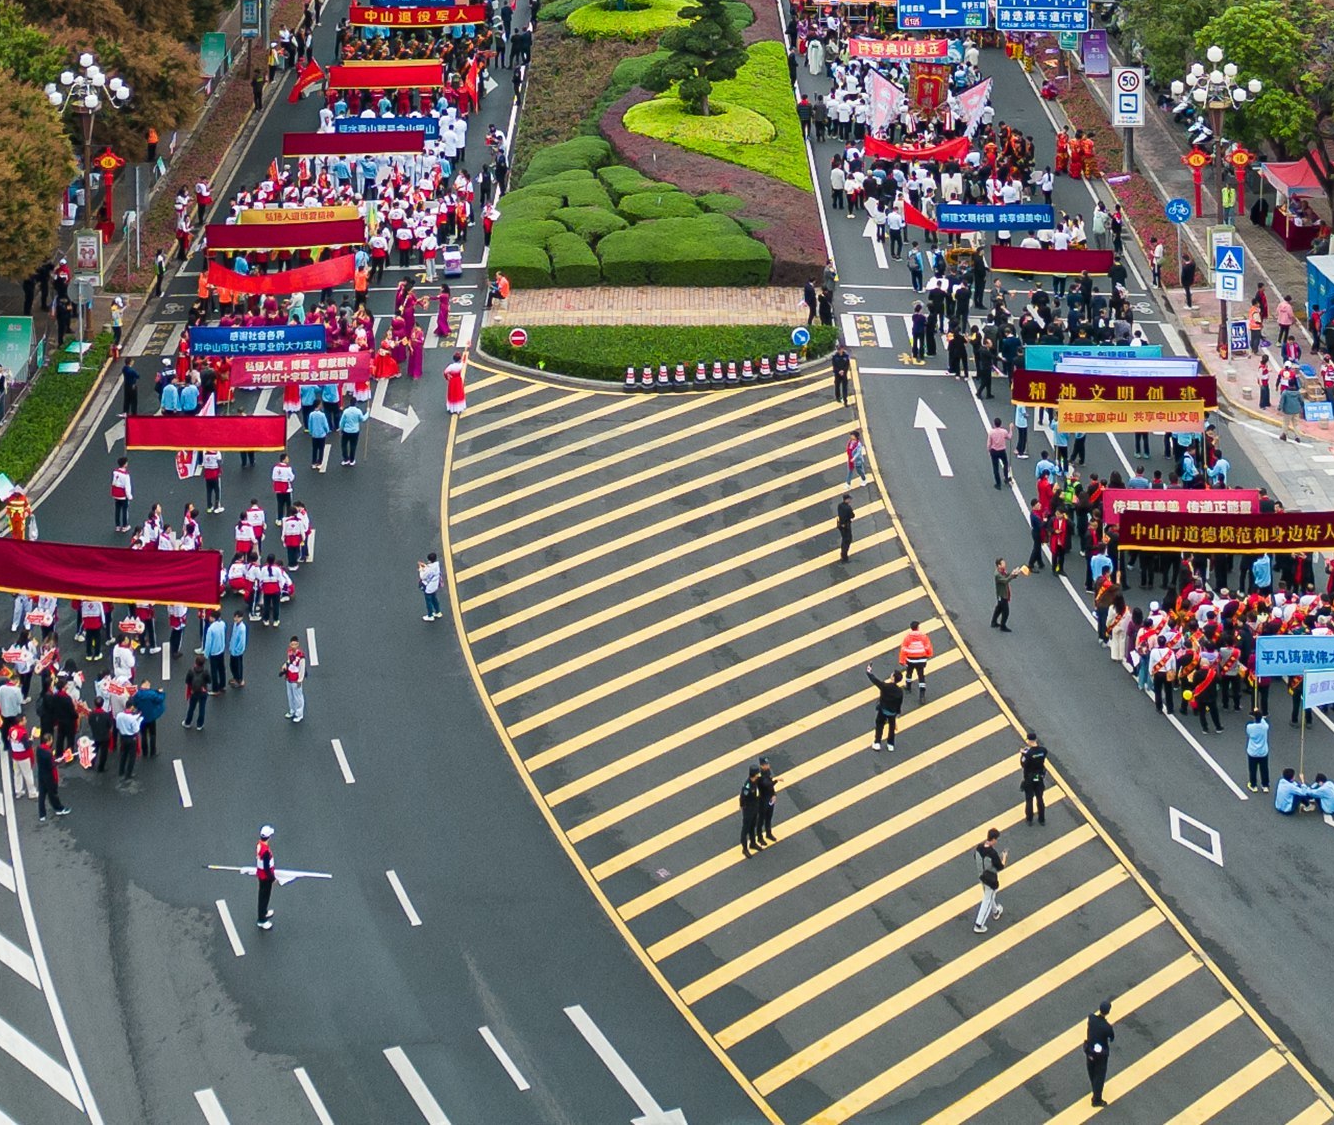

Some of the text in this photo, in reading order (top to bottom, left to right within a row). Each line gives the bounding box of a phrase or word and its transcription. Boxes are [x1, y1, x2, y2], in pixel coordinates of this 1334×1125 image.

[364, 9, 468, 23] 中山退役军人
[1000, 10, 1085, 22] 请选择车道行驶
[1122, 75, 1136, 87] 50
[229, 330, 285, 341] 感谢社会各界
[194, 340, 322, 353] 对中山市红十字事业的大力支持
[1028, 381, 1198, 401] 精神文明创建
[1063, 411, 1200, 423] 共建文明中山 共享中山文明
[1186, 500, 1252, 513] 传递正能量
